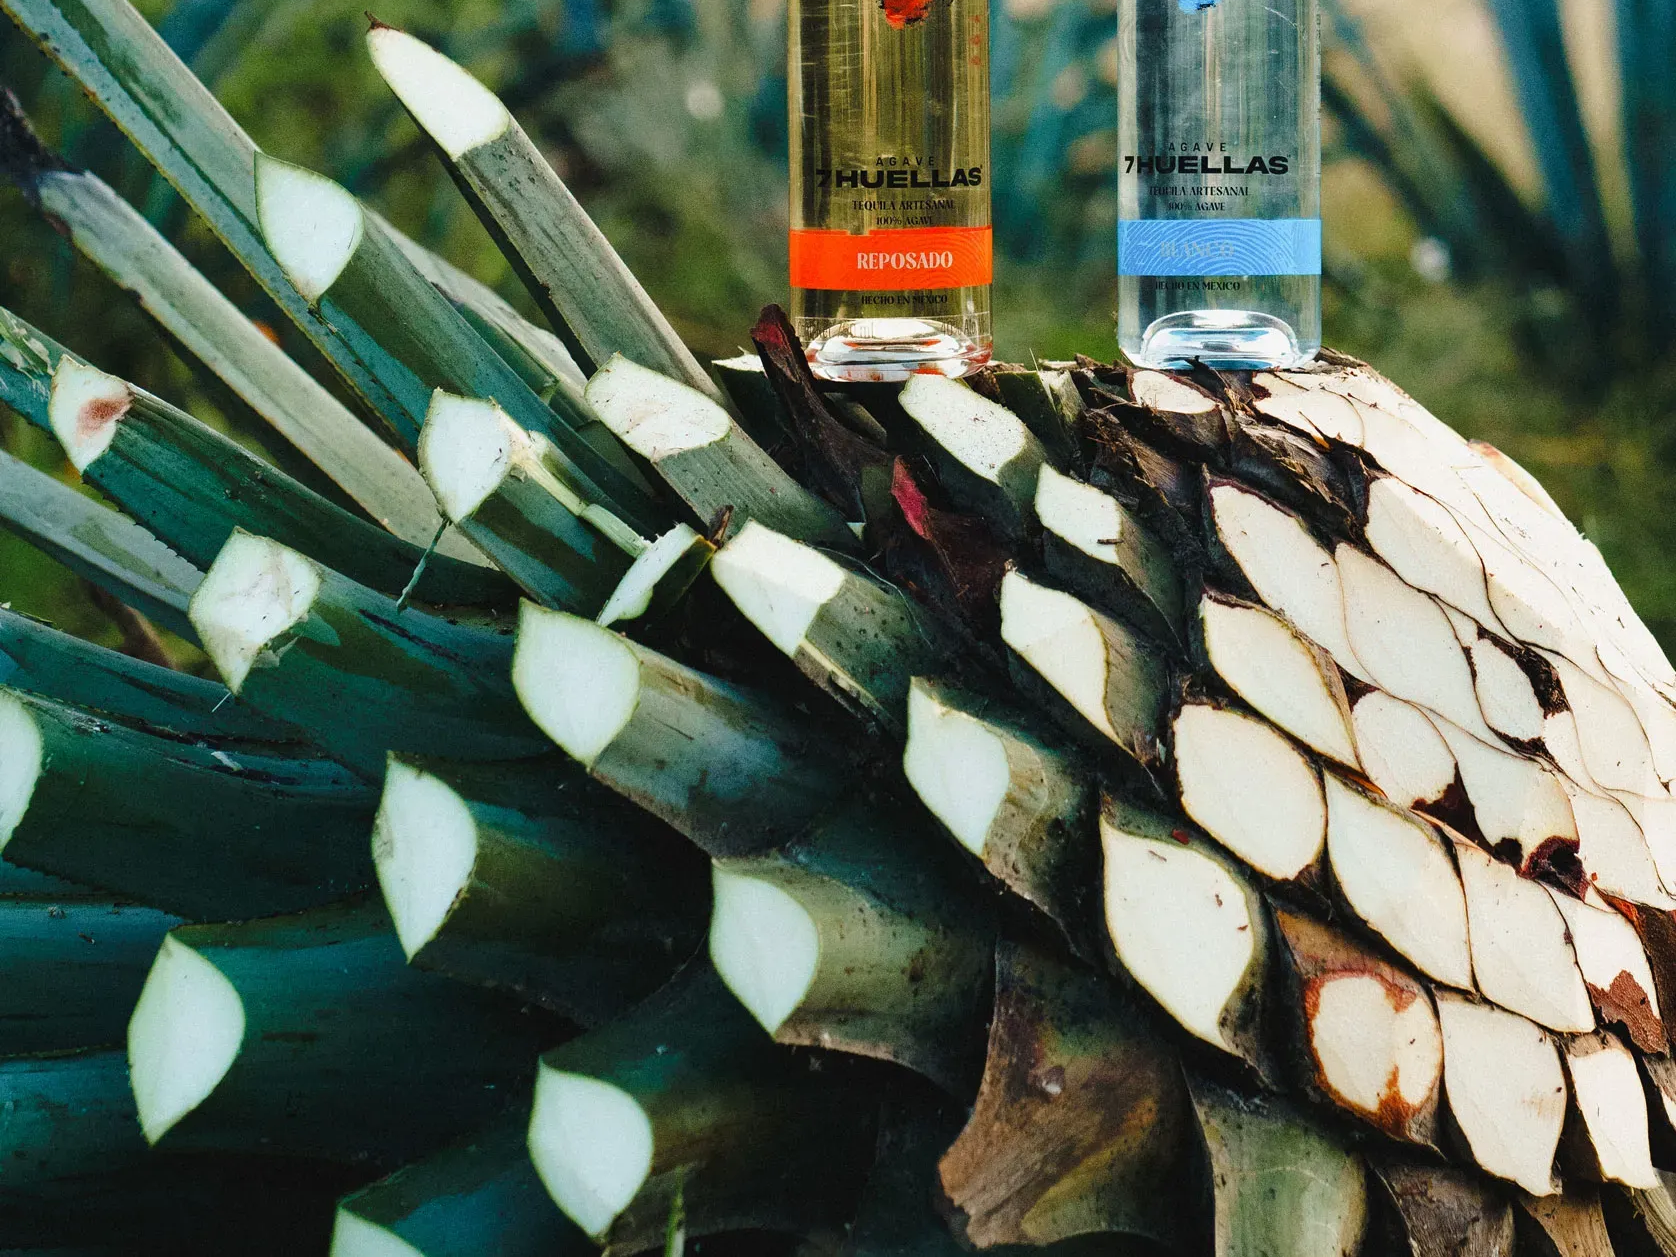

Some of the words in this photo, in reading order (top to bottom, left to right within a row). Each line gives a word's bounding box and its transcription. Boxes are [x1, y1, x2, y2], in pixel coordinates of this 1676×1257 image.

[1168, 142, 1227, 152] AGAVE
[875, 157, 935, 166] AGAVE
[1124, 155, 1289, 175] 7HUELLAS
[816, 167, 982, 188] 7HUELLAS
[1150, 186, 1186, 196] TEQUILA
[1189, 186, 1250, 196] ARTESANAL
[852, 200, 896, 210] TEQUILA
[899, 200, 955, 210] ARTESANAL
[1195, 202, 1226, 211] AGAVE
[876, 217, 902, 225] 100%
[904, 216, 933, 225] AGAVE
[1159, 241, 1235, 258] BLANCO
[857, 251, 953, 269] REPOSADO
[1155, 282, 1185, 290] HECHO
[1187, 282, 1201, 290] EN
[861, 296, 895, 305] HECHO
[897, 296, 911, 304] EN
